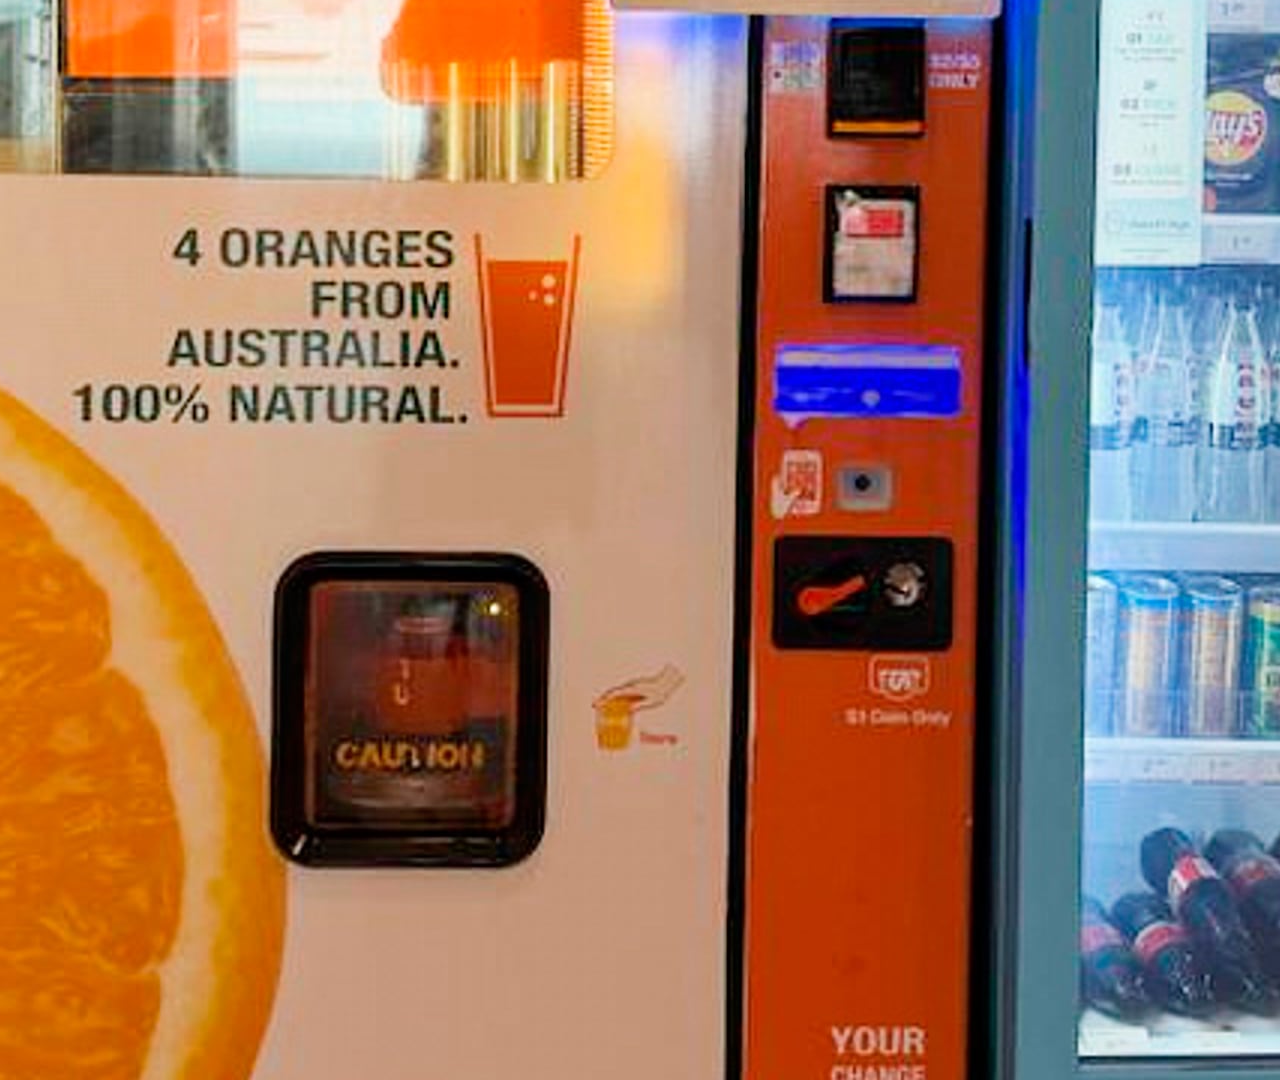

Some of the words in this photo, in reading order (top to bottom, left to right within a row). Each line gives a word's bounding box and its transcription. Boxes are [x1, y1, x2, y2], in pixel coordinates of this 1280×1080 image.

[173, 229, 201, 266] 4
[220, 228, 454, 268] ORANGES
[311, 281, 451, 319] FROM
[167, 329, 460, 368] AUSTRALIA.
[72, 384, 209, 423] 100%
[230, 385, 468, 423] NATURAL.
[336, 741, 489, 768] CAUTION
[831, 1025, 925, 1055] YOUR
